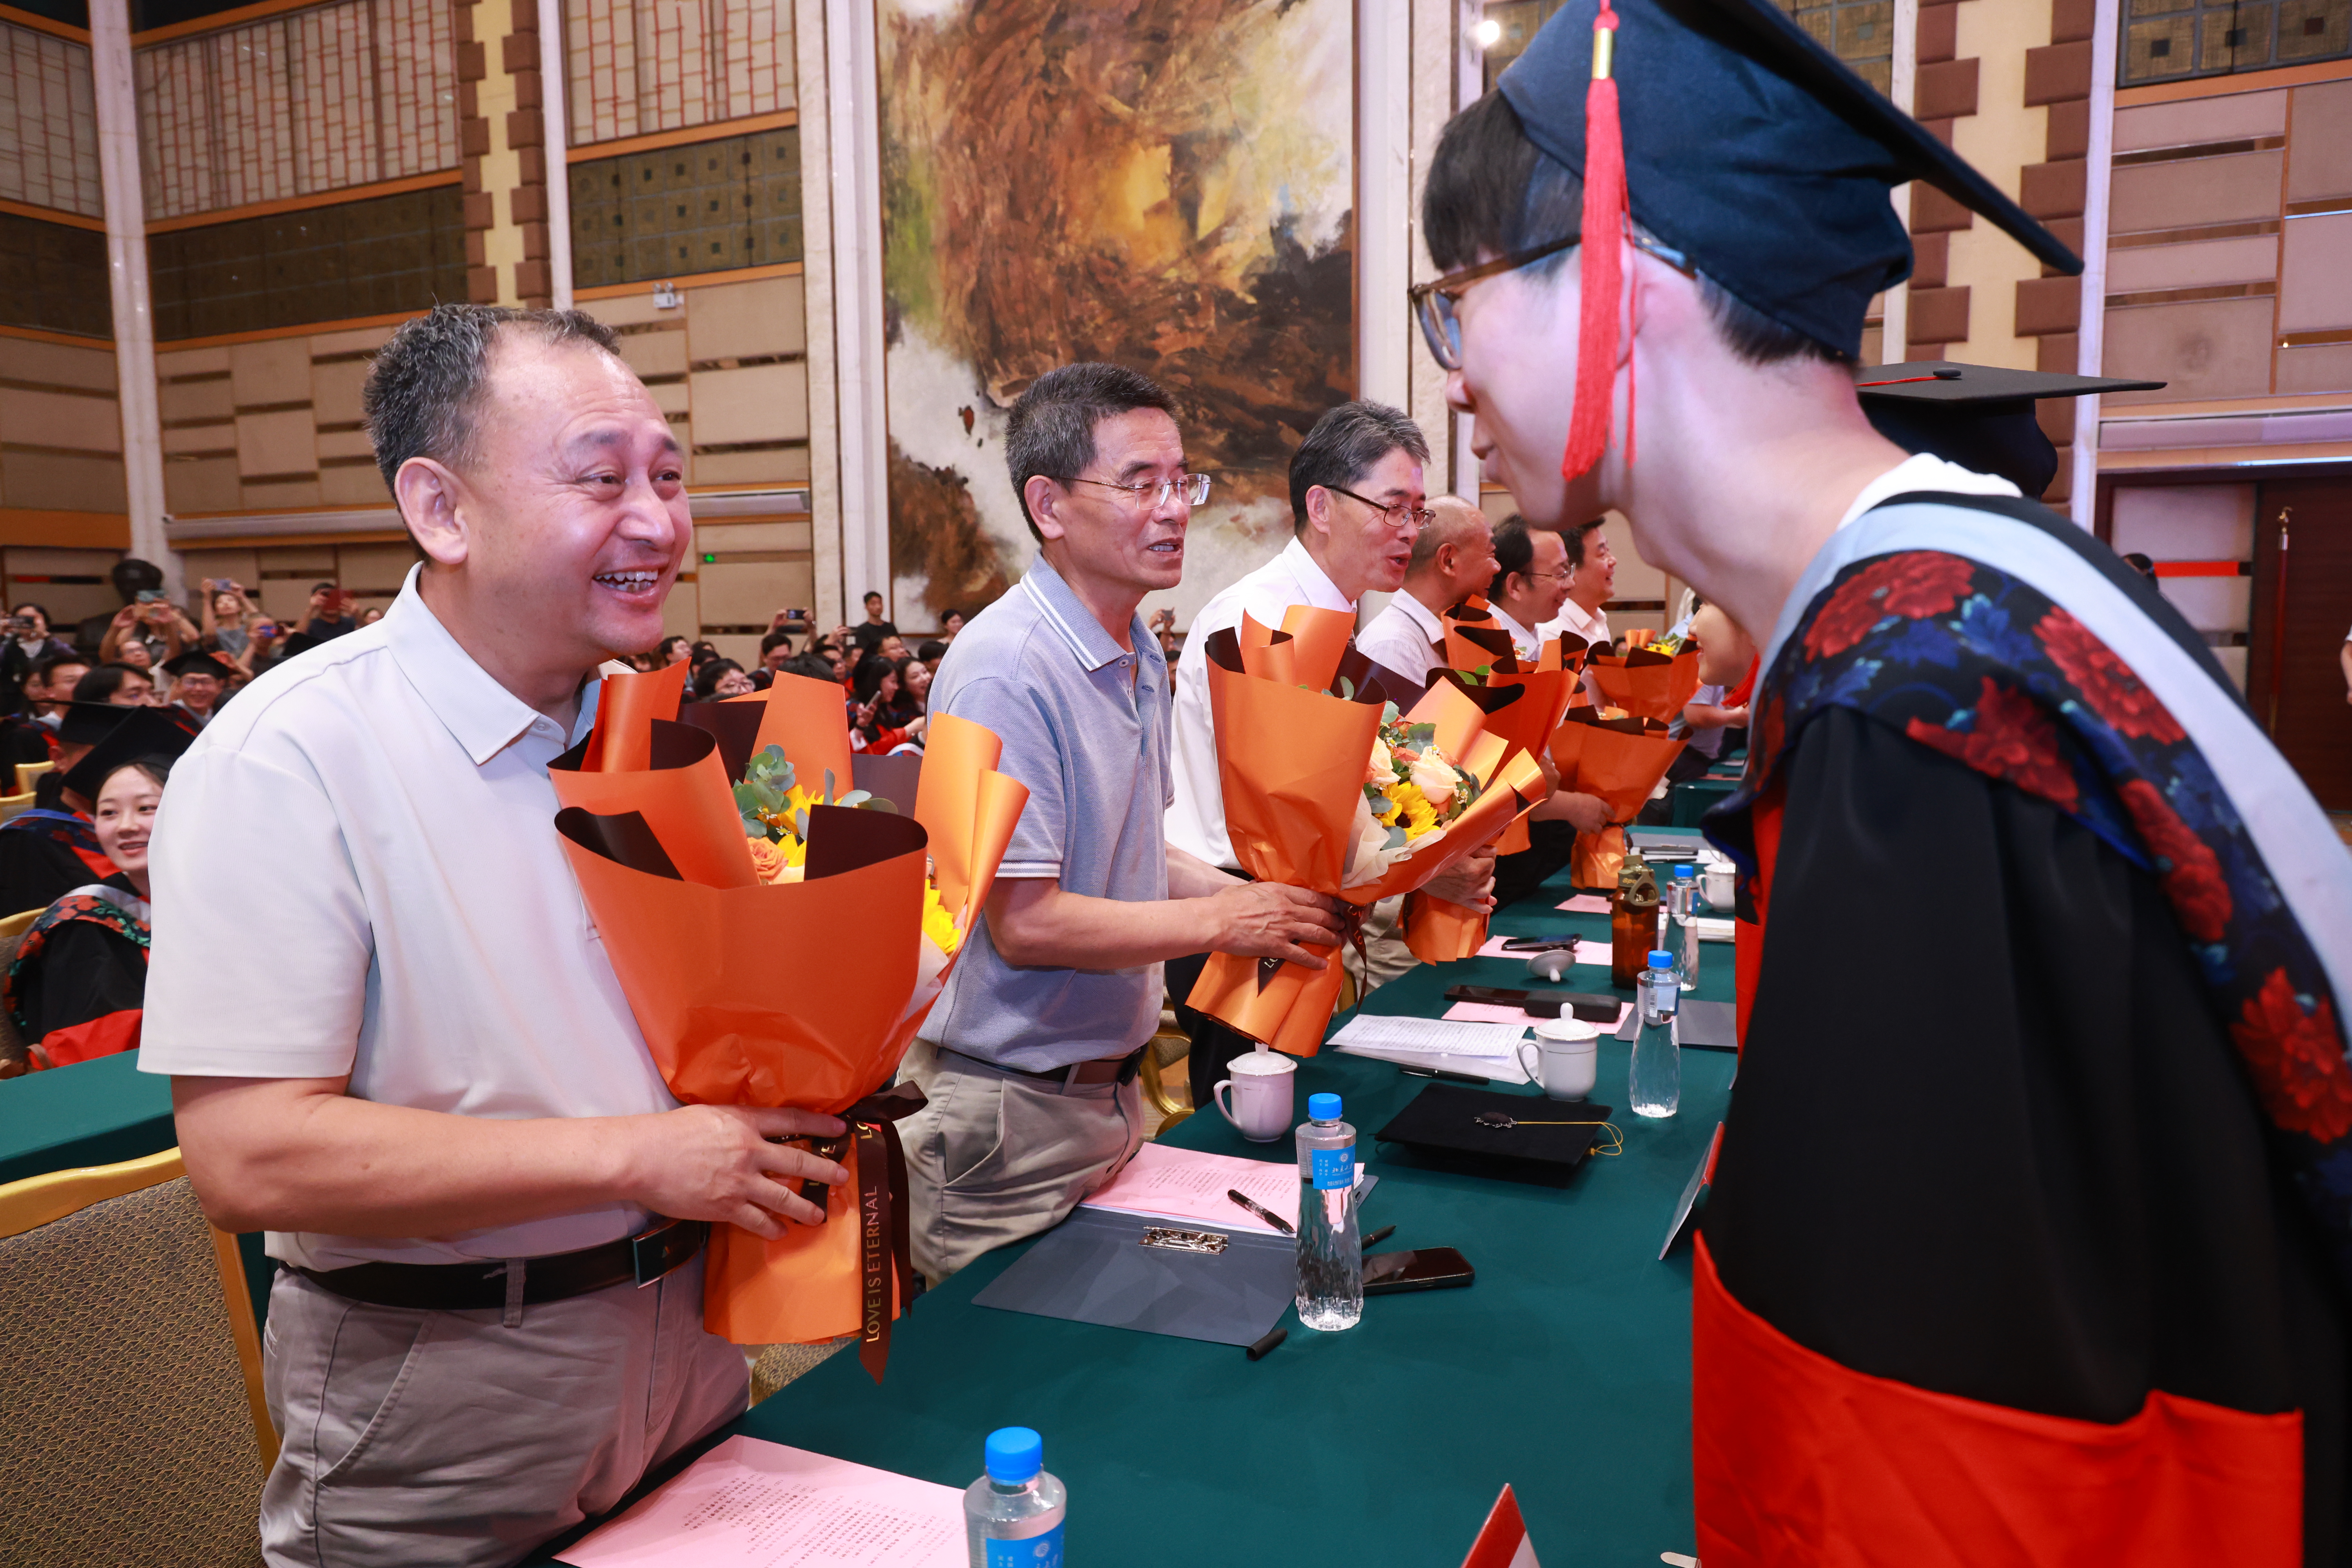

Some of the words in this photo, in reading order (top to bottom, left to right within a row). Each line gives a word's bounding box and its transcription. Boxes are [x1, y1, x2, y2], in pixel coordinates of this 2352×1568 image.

[864, 1186, 880, 1272] ETERNAL
[868, 1277, 881, 1294] IS
[866, 1298, 881, 1343] LOVE
